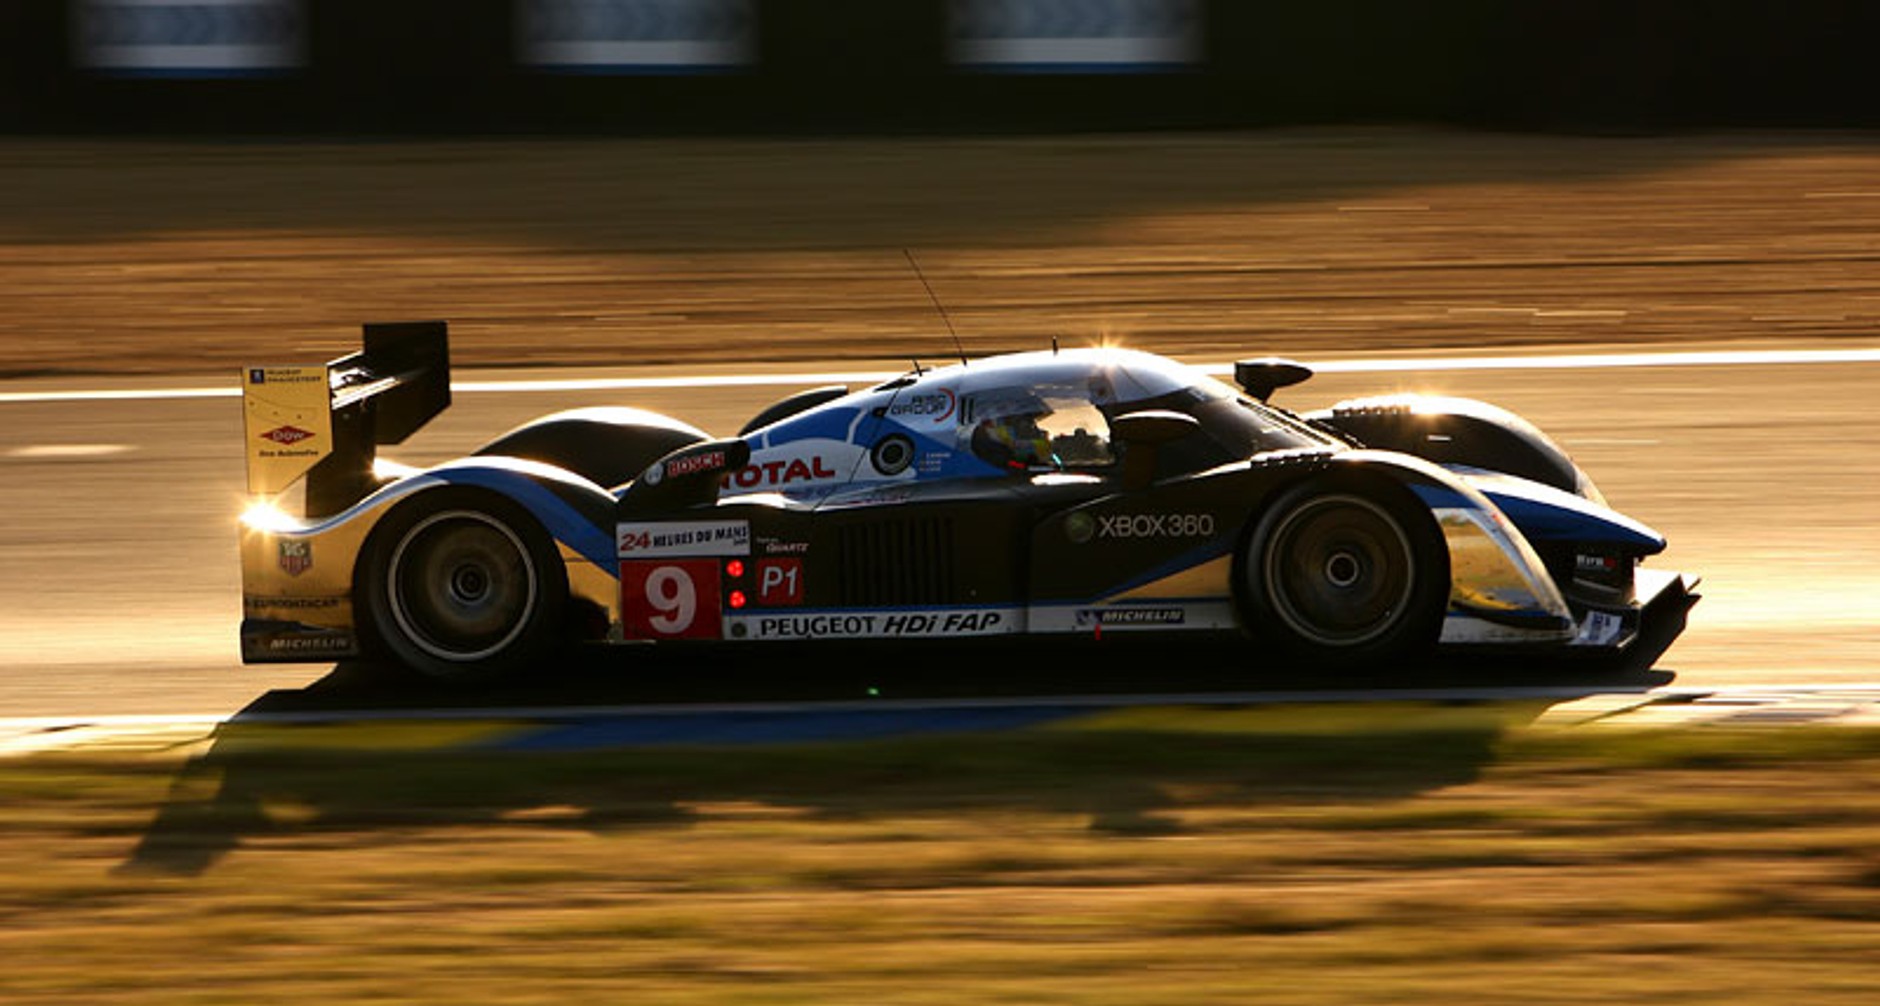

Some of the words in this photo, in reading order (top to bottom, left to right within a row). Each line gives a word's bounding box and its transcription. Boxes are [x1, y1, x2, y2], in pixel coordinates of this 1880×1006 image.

[890, 402, 946, 415] GROUP
[667, 451, 726, 478] BOSCH
[620, 531, 650, 552] 24
[653, 533, 694, 548] HEURES
[696, 530, 713, 543] DU
[715, 525, 748, 541] MANS
[760, 565, 799, 597] P1
[645, 565, 697, 634] 9
[760, 615, 878, 637] PEUGEOT
[882, 613, 940, 634] HDi
[943, 610, 1001, 633] FAP
[1102, 610, 1183, 623] MICHELIN
[270, 637, 347, 650] MICHELIN
